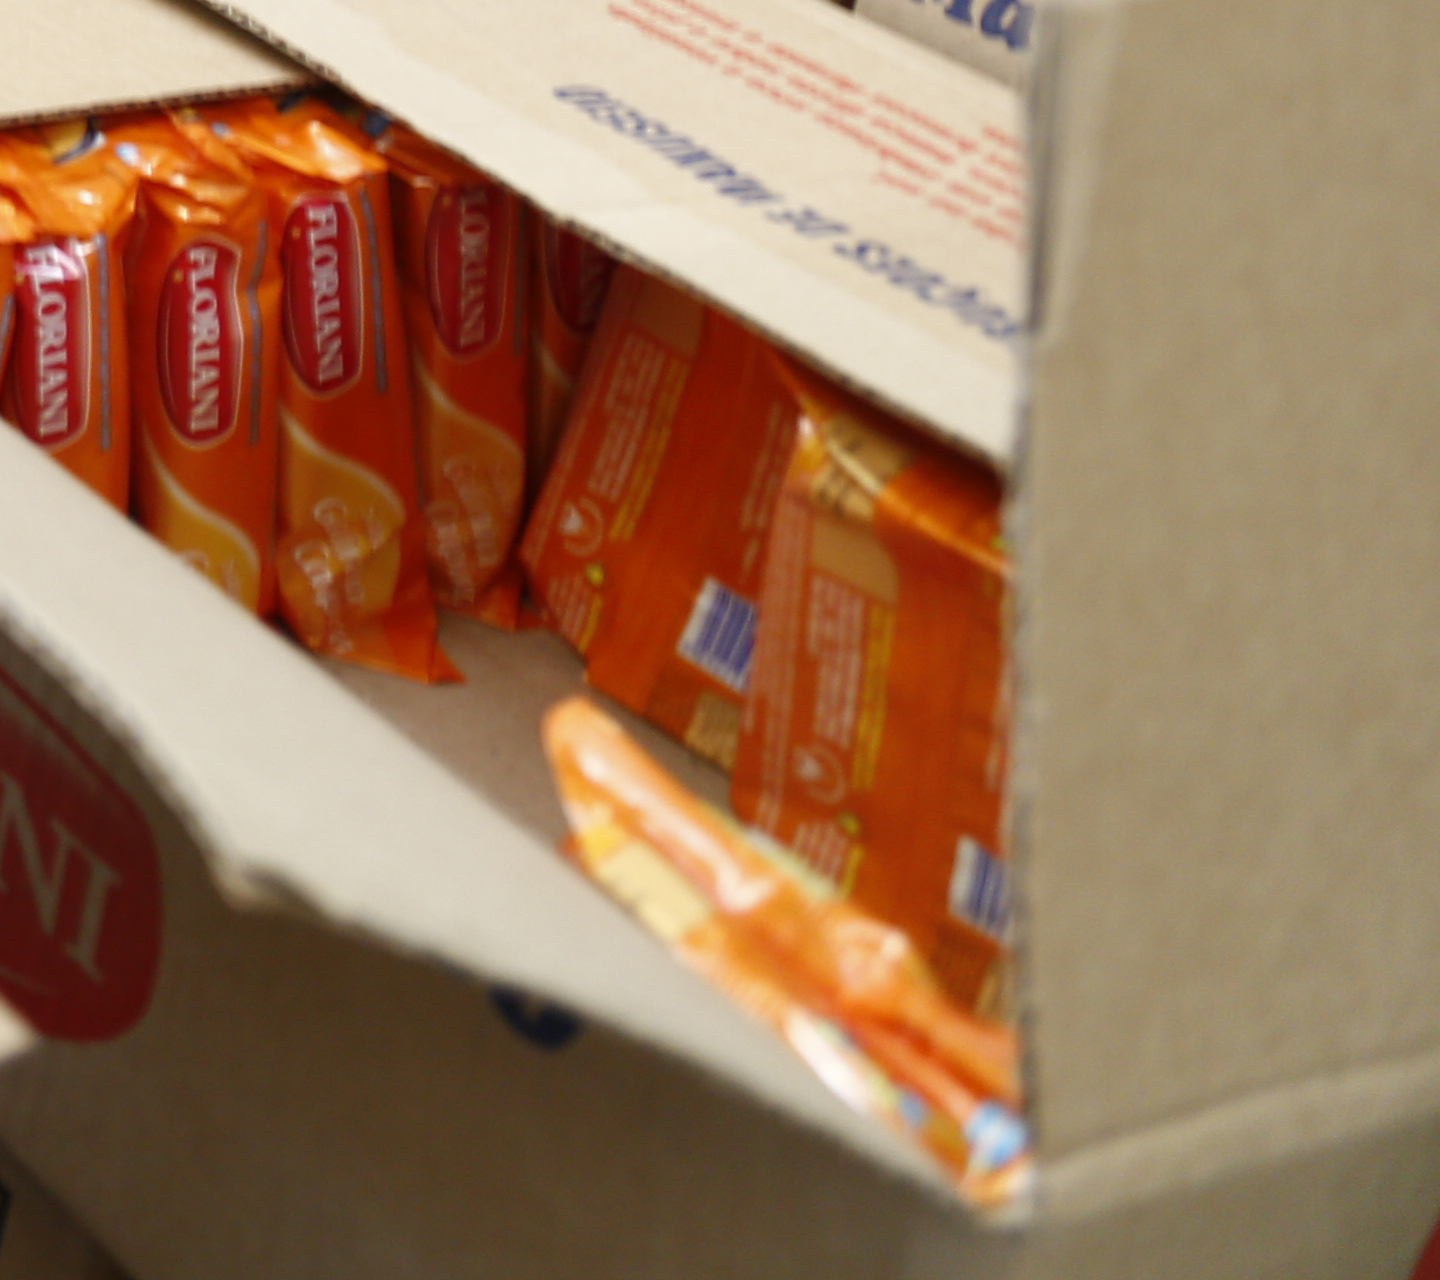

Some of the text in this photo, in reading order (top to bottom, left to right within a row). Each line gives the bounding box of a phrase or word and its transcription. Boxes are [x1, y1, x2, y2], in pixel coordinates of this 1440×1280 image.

[25, 240, 71, 439] FLORIANI
[188, 245, 220, 434] FLORIANI
[307, 203, 345, 384] FLORIANI
